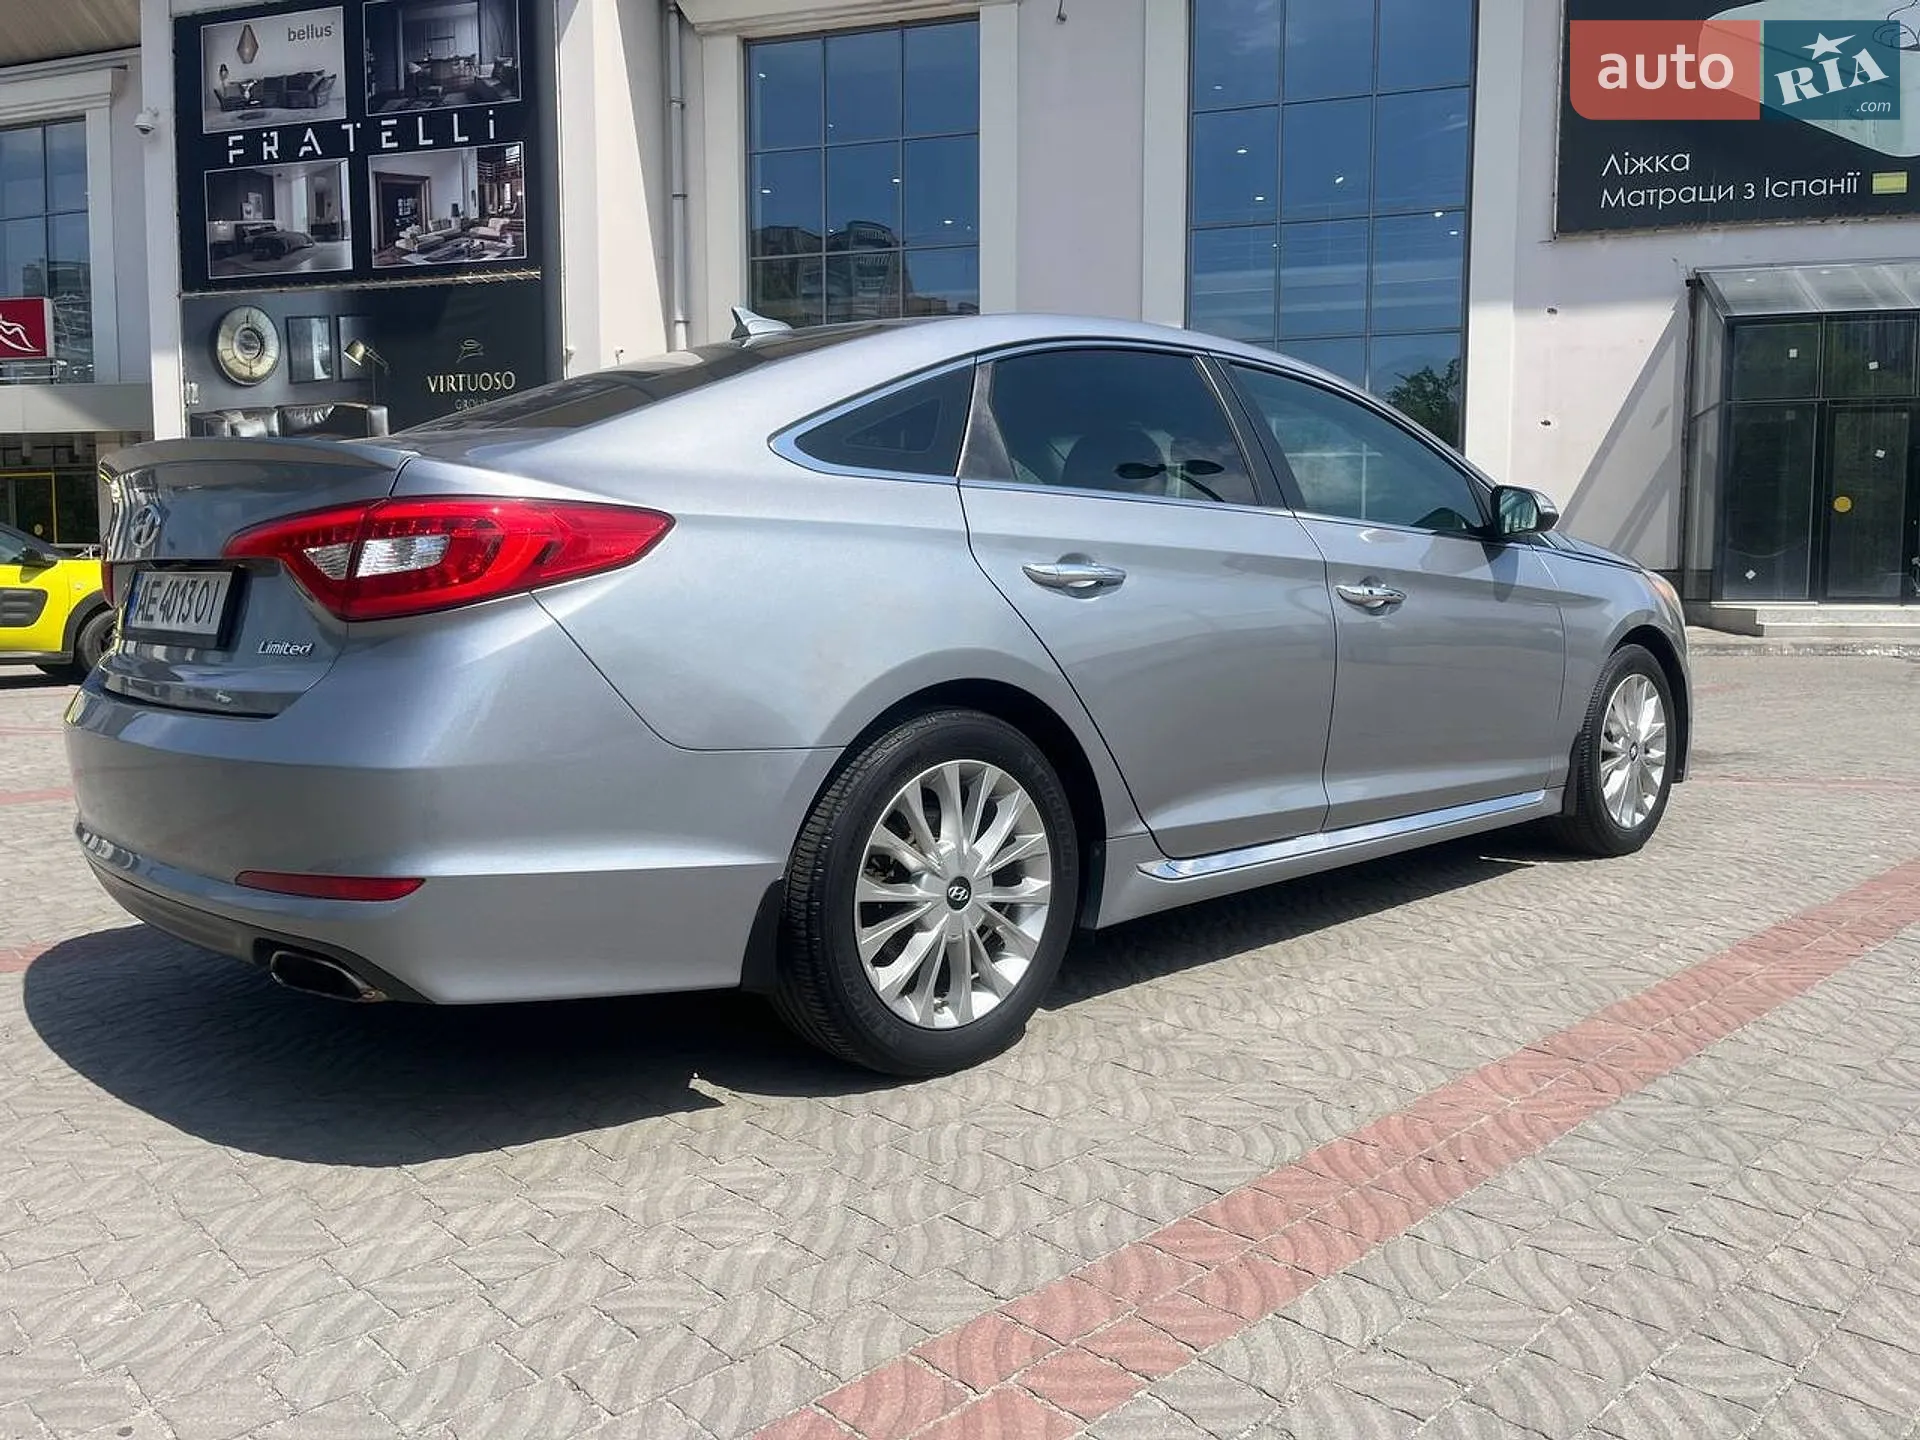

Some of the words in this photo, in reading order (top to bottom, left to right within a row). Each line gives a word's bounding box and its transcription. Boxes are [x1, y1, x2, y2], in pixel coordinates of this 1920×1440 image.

[288, 24, 331, 41] bellus
[1602, 152, 1691, 177] Ліжка
[1600, 184, 1735, 210] Матраци
[1743, 182, 1756, 200] з
[1764, 171, 1862, 199] Іспанії
[427, 371, 516, 393] VIRTUOSO
[257, 640, 313, 656] Limited
